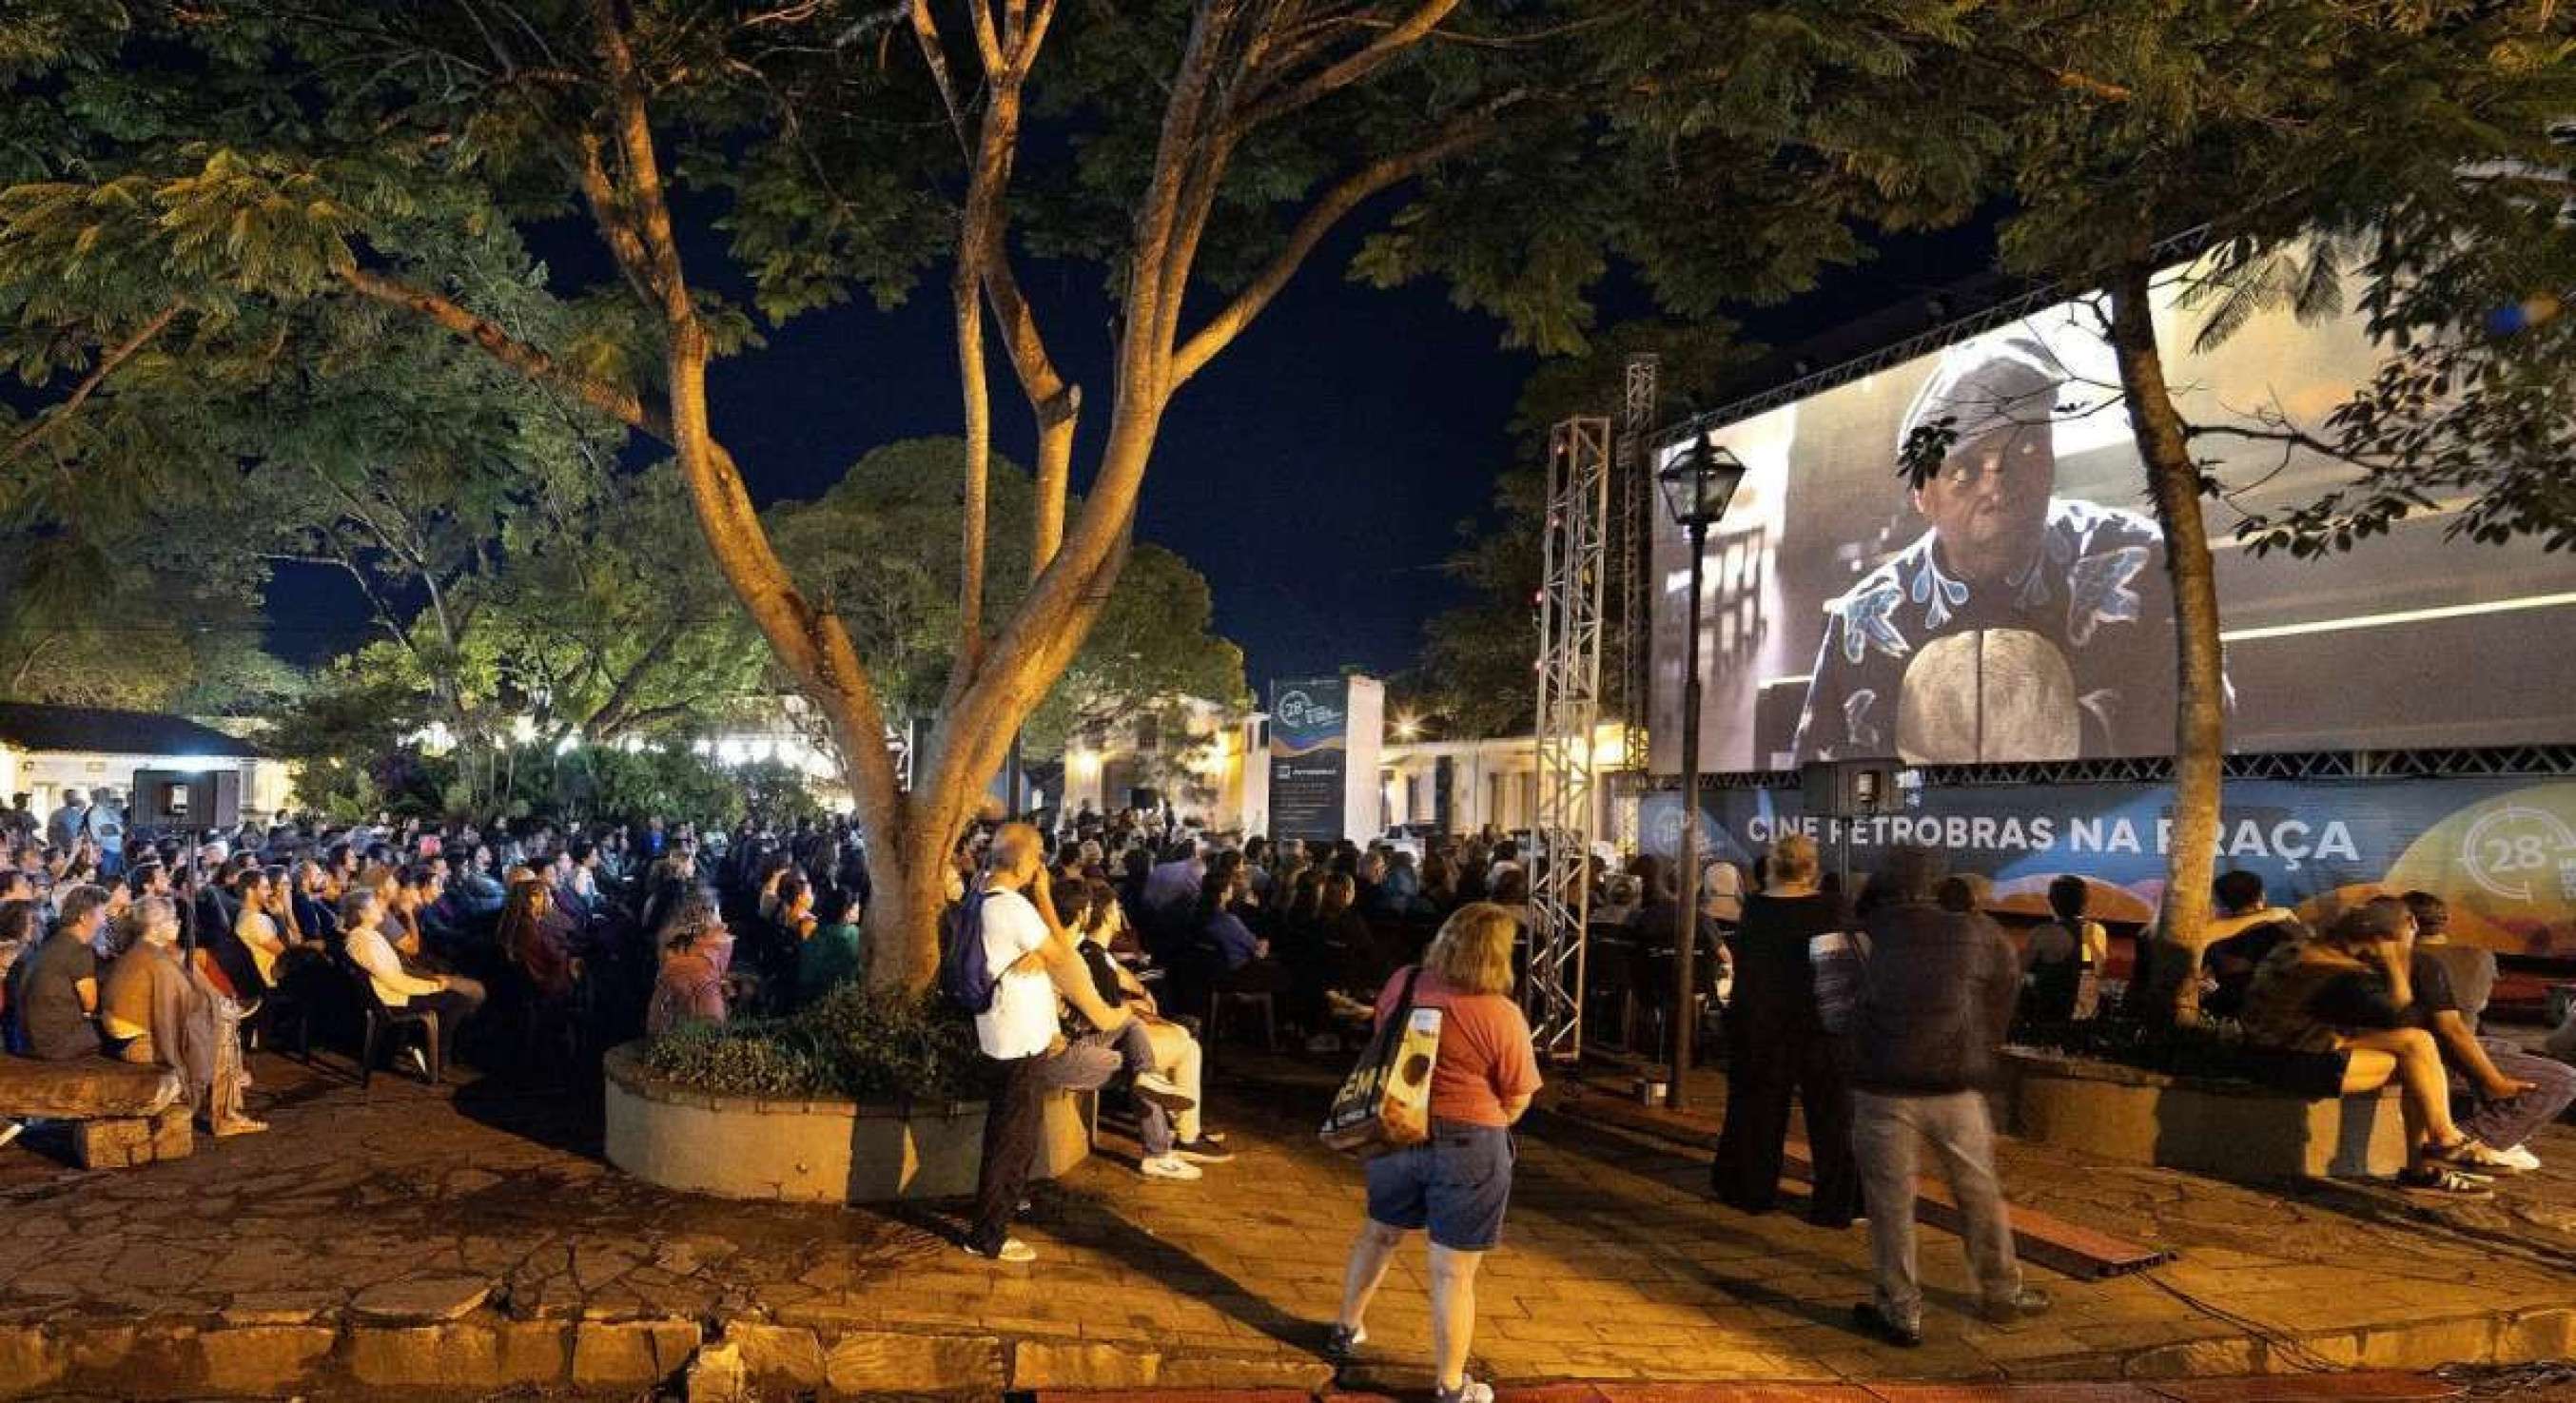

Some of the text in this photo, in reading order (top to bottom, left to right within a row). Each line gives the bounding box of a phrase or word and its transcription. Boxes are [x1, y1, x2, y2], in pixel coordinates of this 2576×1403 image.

[1748, 816, 1820, 844] CINE
[1828, 816, 2055, 850] PETROBRAS
[2070, 818, 2142, 853] NA
